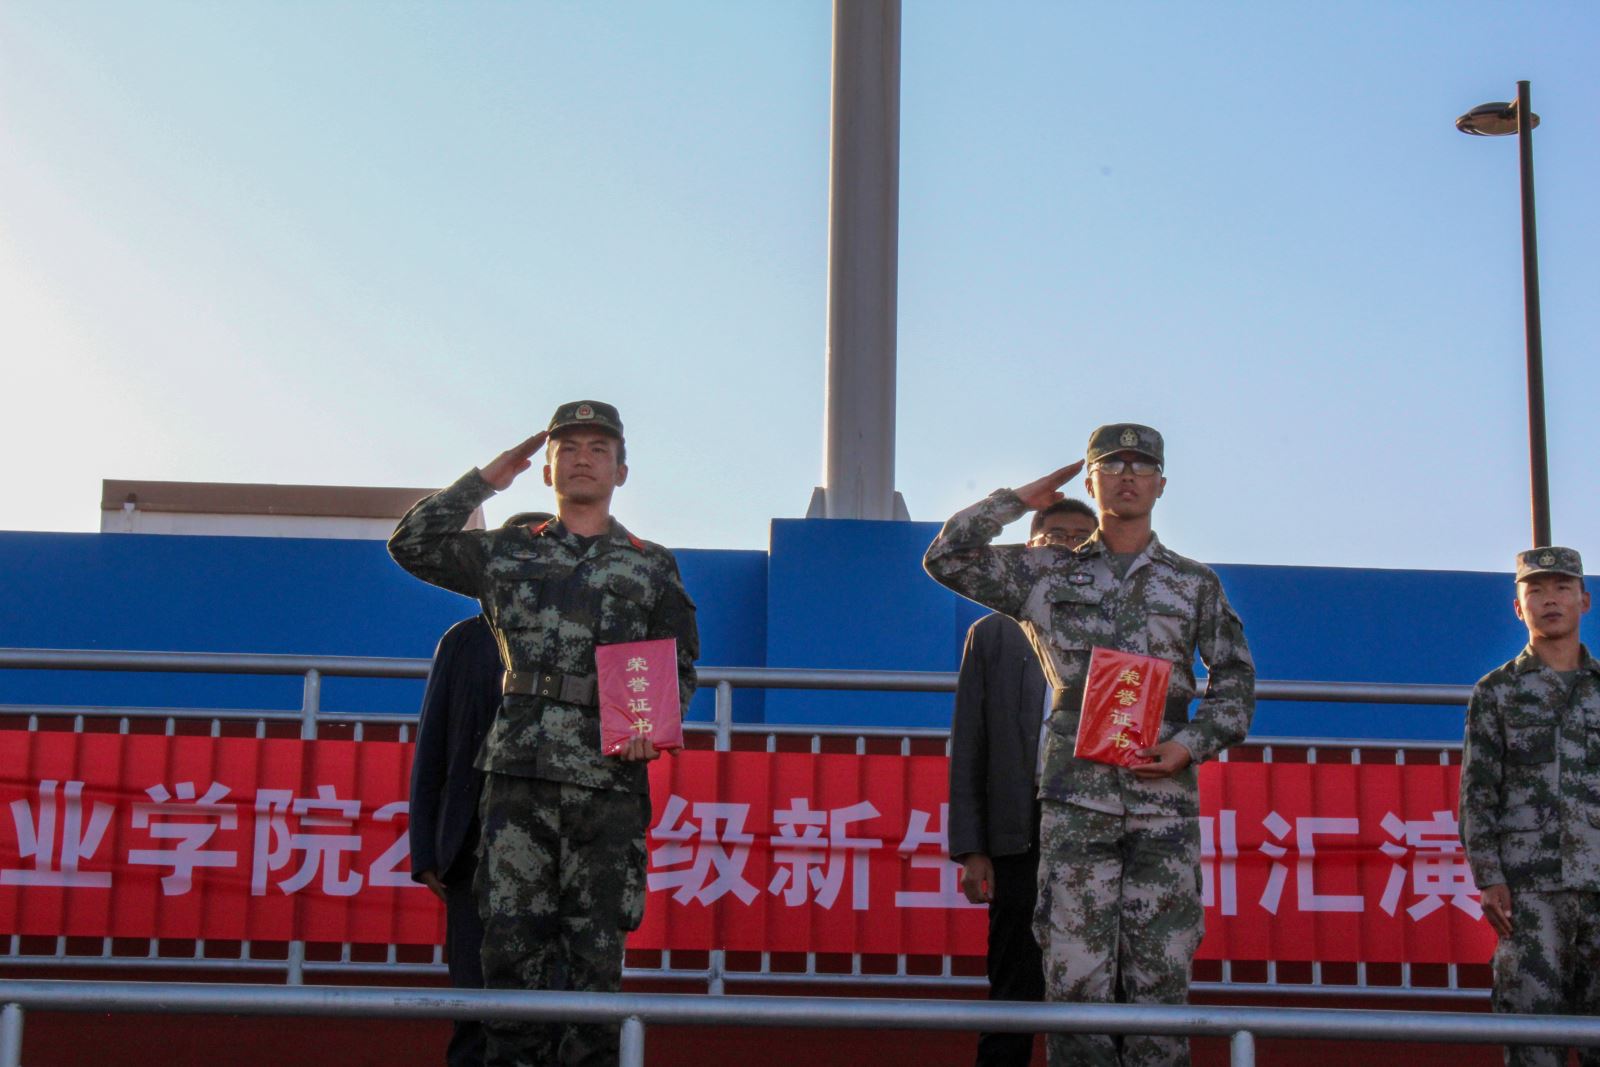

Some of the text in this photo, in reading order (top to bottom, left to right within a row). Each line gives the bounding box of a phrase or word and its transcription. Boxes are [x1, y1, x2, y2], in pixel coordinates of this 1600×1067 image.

[625, 657, 653, 736] 荣誉证书
[1107, 669, 1142, 748] 荣誉证书
[647, 794, 989, 909] 级新生
